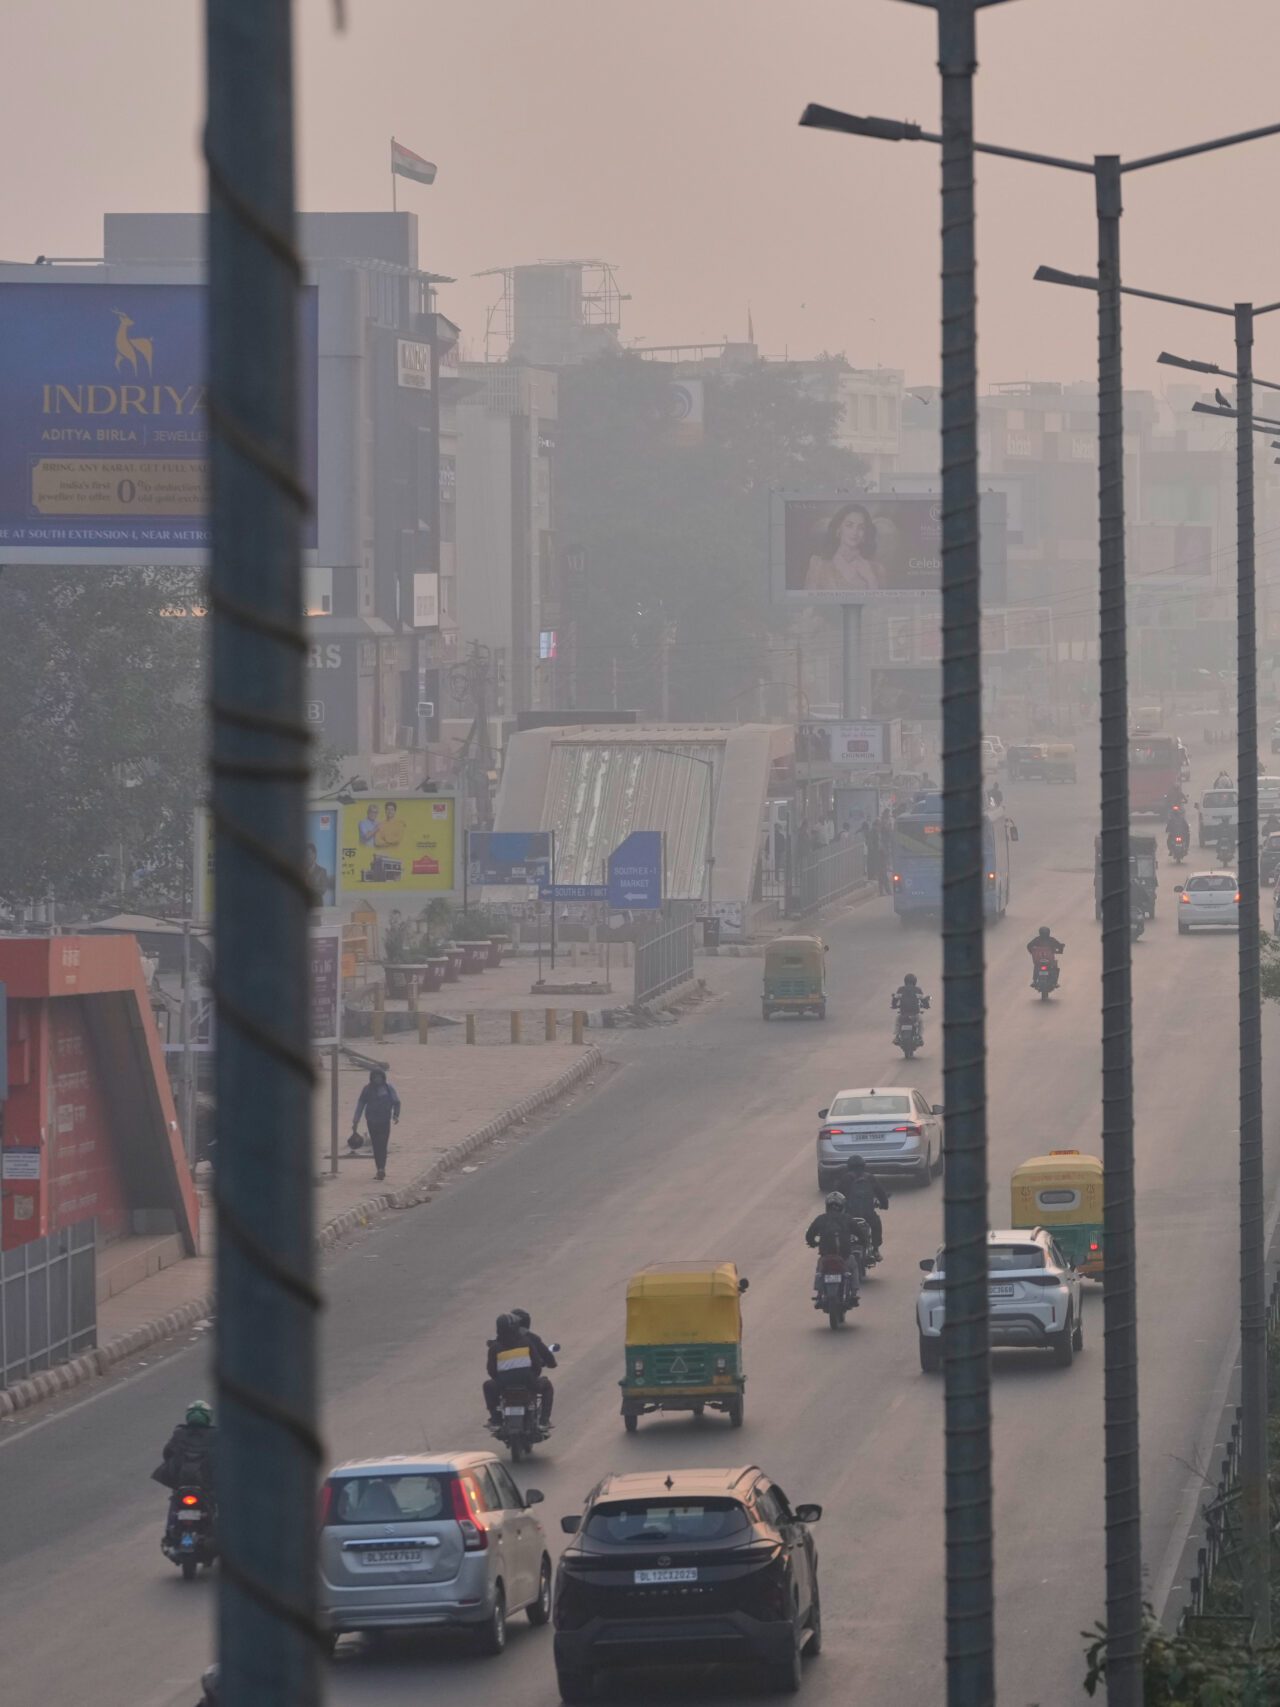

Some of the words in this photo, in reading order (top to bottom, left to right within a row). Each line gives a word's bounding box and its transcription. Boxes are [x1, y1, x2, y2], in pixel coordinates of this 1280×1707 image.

[41, 428, 92, 441] ADITYA
[96, 428, 137, 441] BIRLA
[152, 430, 209, 442] JEWELLE
[42, 463, 74, 473] BRING
[78, 463, 99, 473] ANY
[139, 463, 159, 473] GET
[161, 463, 187, 473] FULL
[92, 480, 111, 490] first
[12, 530, 27, 540] AT
[29, 529, 66, 540] SOUTH
[141, 530, 171, 541] NEAR
[614, 867, 638, 876] SOUTH
[638, 867, 650, 876] EX
[620, 879, 650, 889] MARKET
[554, 887, 577, 898] SOUTH
[577, 887, 587, 898] EX
